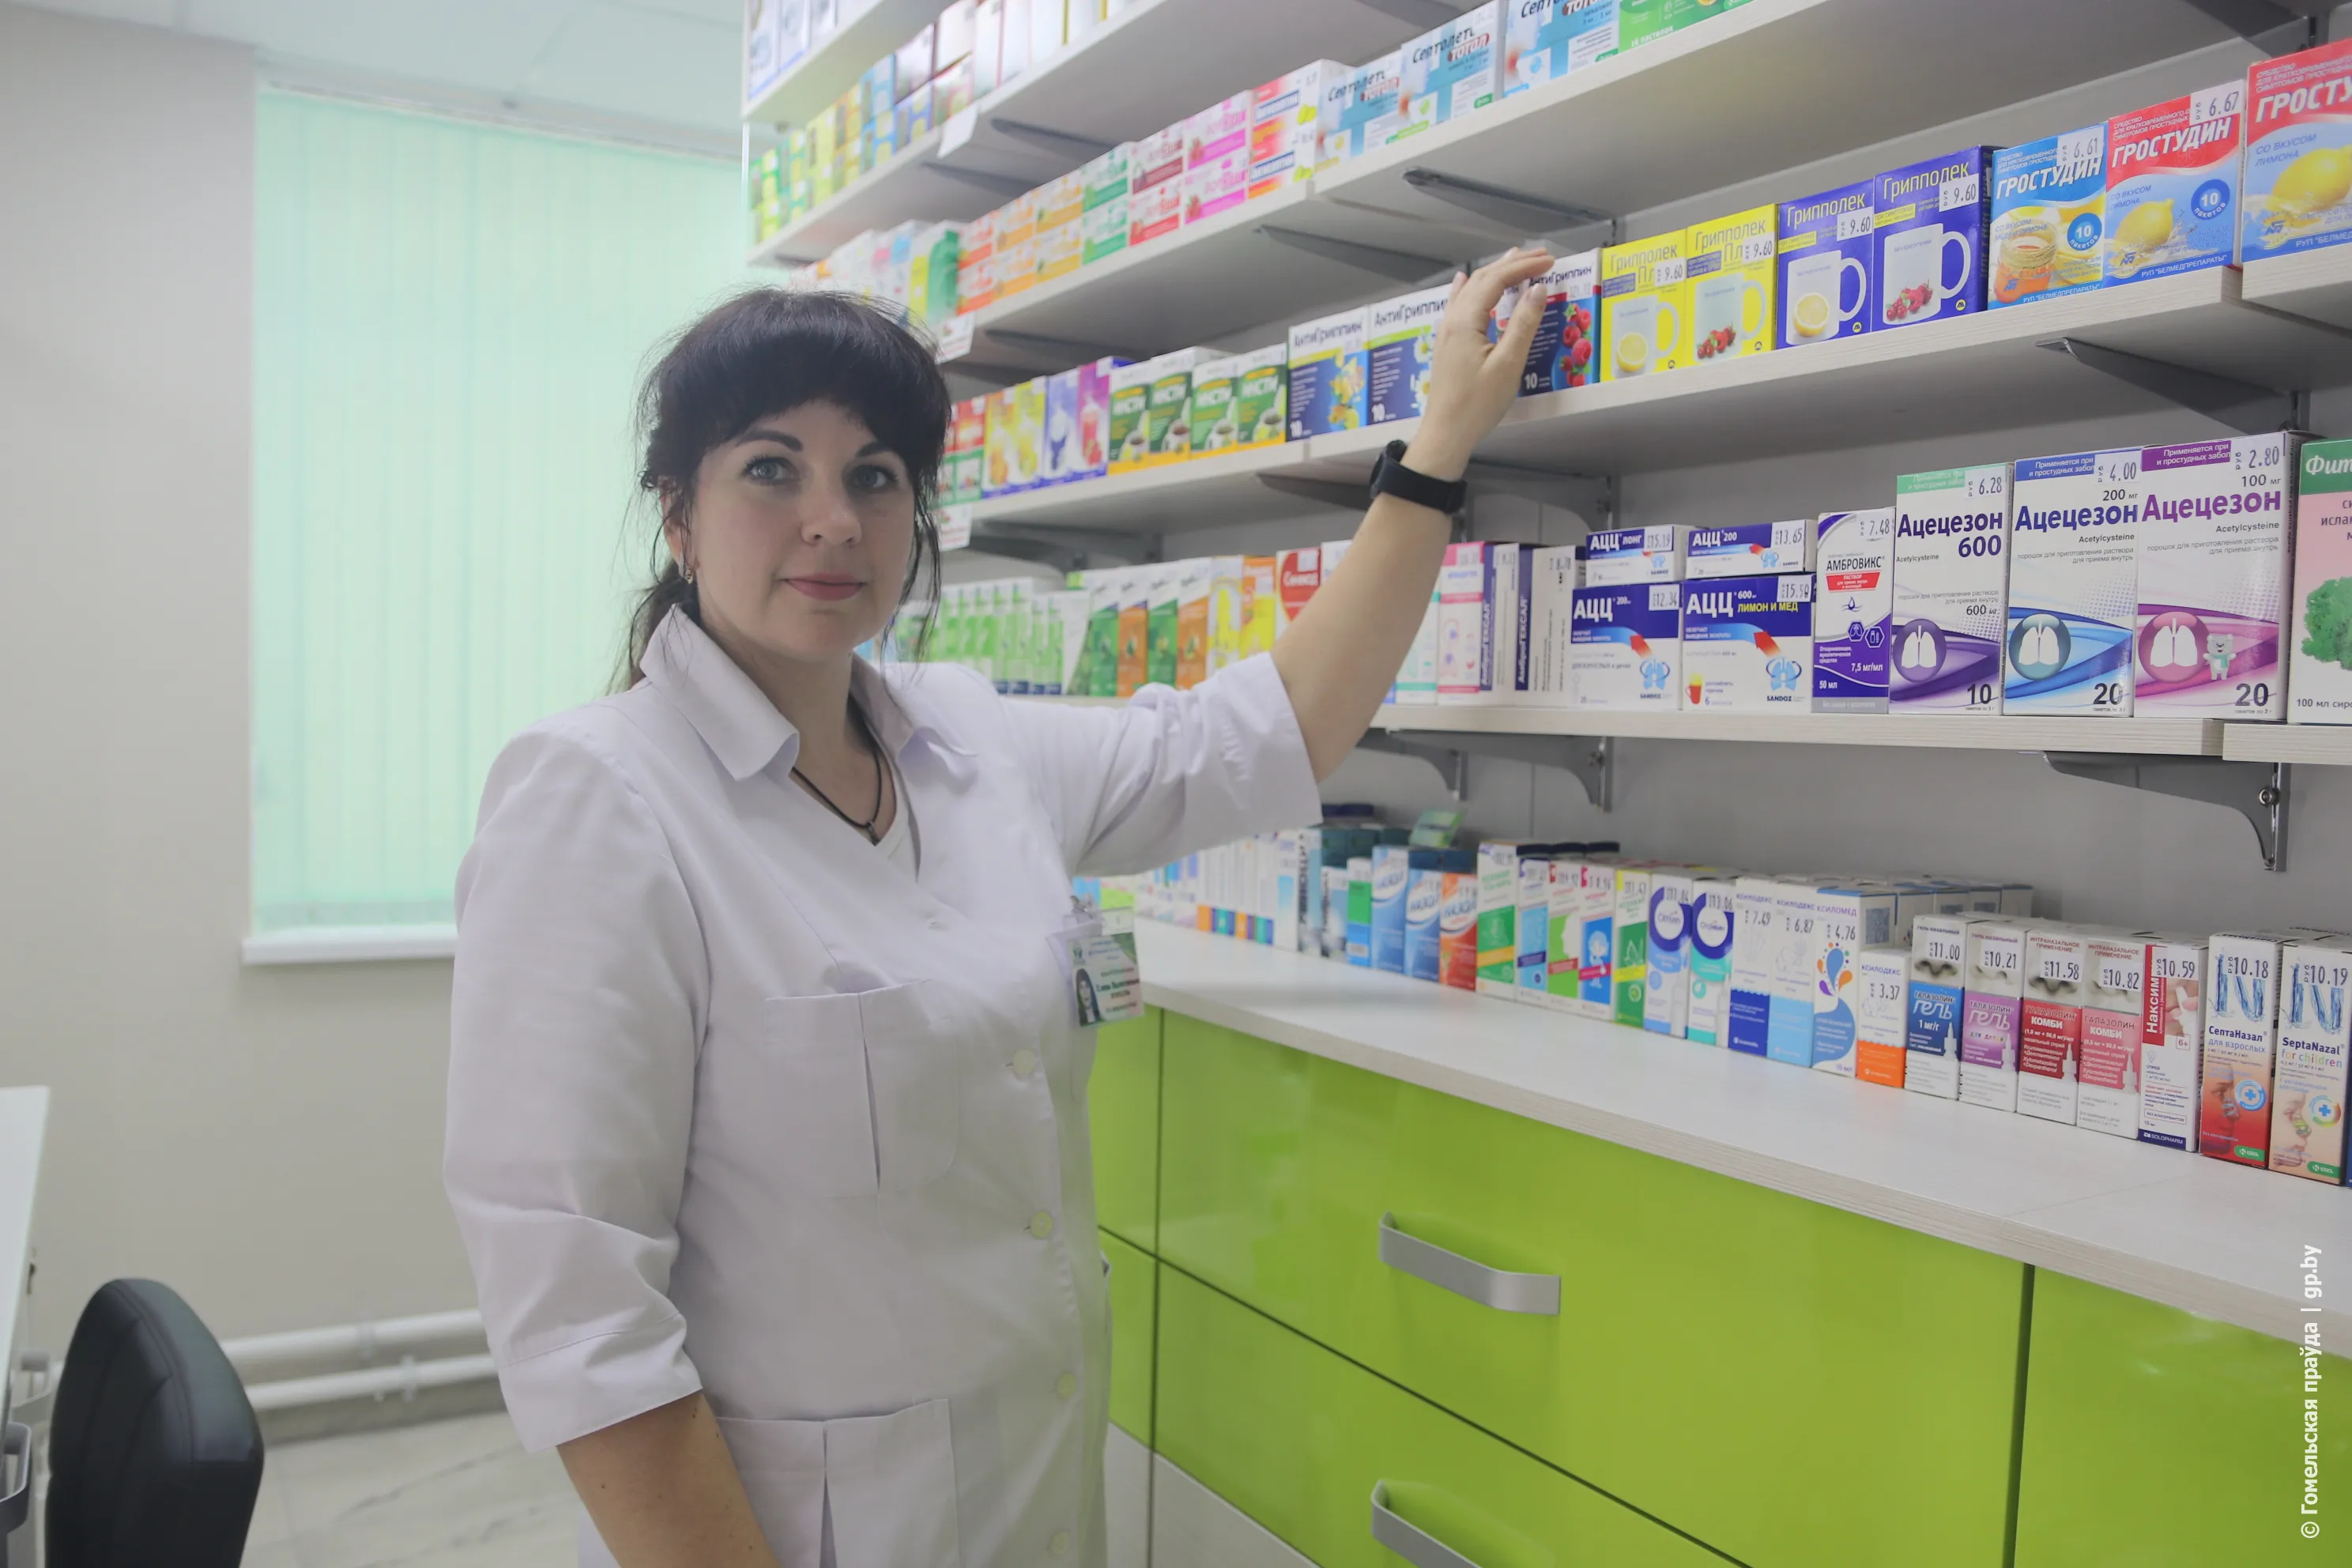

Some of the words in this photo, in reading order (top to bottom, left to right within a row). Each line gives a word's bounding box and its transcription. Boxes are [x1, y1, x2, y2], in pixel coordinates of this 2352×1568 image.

[1413, 27, 1475, 63] Септолет
[2209, 91, 2239, 117] 6.67
[2113, 126, 2125, 134] ДЛЯ
[2125, 110, 2184, 131] КРАТКОВРЕМЕННОГО
[2113, 127, 2148, 141] СИМПТОМОВ
[2149, 115, 2188, 131] ПРОСТУДНЫХ
[2114, 116, 2143, 130] СРЕДСТВО
[2074, 138, 2098, 158] 6.61
[2112, 116, 2232, 168] ГРОСТУДИН
[2256, 145, 2271, 155] СО
[2274, 134, 2317, 150] ВКУСОМ
[2255, 149, 2299, 167] ЛИМОНА
[1883, 162, 1969, 202] Грипполек
[1996, 156, 2104, 200] ГРОСТУДИН
[1954, 183, 1977, 203] 9.60
[2122, 185, 2151, 198] ВКУСОМ
[2201, 192, 2218, 207] 10
[1787, 193, 1866, 229] Грипполек
[2194, 202, 2226, 218] пакетов
[1849, 217, 1871, 235] 9.60
[2075, 225, 2091, 238] 10
[1695, 220, 1766, 253] Грипполек
[2070, 234, 2099, 250] пакетов
[2296, 236, 2313, 247] РУП
[1754, 240, 1773, 257] 9.60
[1610, 244, 1678, 275] Грипполек
[2142, 269, 2154, 277] РУП
[2155, 254, 2227, 275] "БЕЛМЕДПРЕПАРАТЫ"
[1664, 265, 1683, 283] 9.60
[2022, 295, 2035, 303] РУП
[1374, 299, 1449, 329] АнтиГриппи
[1525, 372, 1537, 390] 10
[1372, 405, 1385, 421] 10
[2164, 444, 2213, 457] Применяется
[2214, 443, 2229, 452] при
[2248, 446, 2279, 469] 2.80
[2035, 459, 2079, 469] Применяется
[2162, 454, 2207, 466] простудных
[2034, 466, 2073, 477] простудных
[2110, 462, 2136, 481] 4.00
[1979, 477, 2002, 495] 6.28
[2241, 474, 2267, 487] 100
[2103, 489, 2125, 501] 200
[2142, 491, 2281, 522] Ацецезон
[1870, 518, 1890, 536] 7.48
[1898, 512, 2003, 539] Ацецезон
[2015, 504, 2138, 533] Ацецезон
[2216, 522, 2279, 533] Acetylcysteine
[1589, 533, 1619, 552] АЦЦ
[1692, 532, 1721, 547] АЦЦ
[1723, 532, 1737, 542] 200
[1779, 530, 1803, 545] 13.65
[2079, 533, 2135, 543] Acetylcysteine
[2192, 539, 2242, 549] приготовления
[1958, 535, 2002, 558] 600
[1826, 556, 1881, 571] АМБРОВИКС
[1896, 554, 1939, 563] Acetylcysteine
[1574, 597, 1614, 623] АЦЦ
[1686, 592, 1733, 618] АЦЦ
[1738, 590, 1752, 600] 600
[1738, 602, 1769, 612] ЛИМОН
[1770, 602, 1777, 612] И
[1779, 601, 1798, 612] МЕД
[1966, 605, 1986, 616] 600
[1851, 663, 1861, 673] 7,5
[1863, 662, 1883, 672] мг/мл
[1819, 680, 1826, 688] 50
[1967, 684, 1992, 704] 10
[2093, 683, 2123, 705] 20
[2235, 683, 2269, 707] 20
[2297, 699, 2313, 708] 100
[1817, 905, 1857, 917] КСИЛОМЕД
[1835, 925, 1856, 940] 4.76
[2030, 936, 2080, 948] ИНТРАНАЗАЛЬНОЕ
[2036, 943, 2072, 953] ПРИМЕНЕНИЕ
[2088, 944, 2139, 956] ИНТРАНАЗАЛЬНОЕ
[1935, 942, 1960, 961] 11.00
[2094, 951, 2132, 960] ПРИМЕНЕНИЕ
[1989, 952, 2017, 969] 10.21
[2162, 958, 2196, 978] 10.59
[2233, 956, 2269, 979] 10.18
[1861, 964, 1902, 976] КСИЛОДЕКС
[2049, 960, 2079, 980] 11.58
[2311, 964, 2348, 986] 10.19
[2109, 969, 2139, 989] 10.82
[1879, 983, 1900, 1000] 3.37
[1915, 991, 1953, 1002] ГАЛАЗОЛИН
[1969, 1001, 2011, 1013] ГАЛАЗОЛИН
[2026, 1004, 2075, 1021] ГАЛАЗОЛИН
[1919, 1020, 1922, 1028] 1
[2031, 1016, 2063, 1029] КОМБИ
[2084, 1016, 2135, 1029] ГАЛАЗОЛИН
[2024, 1037, 2049, 1046] назальный
[2090, 1027, 2123, 1039] КОМБИ
[2209, 1025, 2263, 1042] СептаНазал
[2083, 1048, 2109, 1057] назальный
[2226, 1042, 2266, 1054] взрослых
[2282, 1037, 2341, 1055] SeptaNazal
[2282, 1049, 2296, 1060] for
[2299, 1052, 2343, 1068] children
[2150, 1133, 2184, 1144] SOLOPHARM
